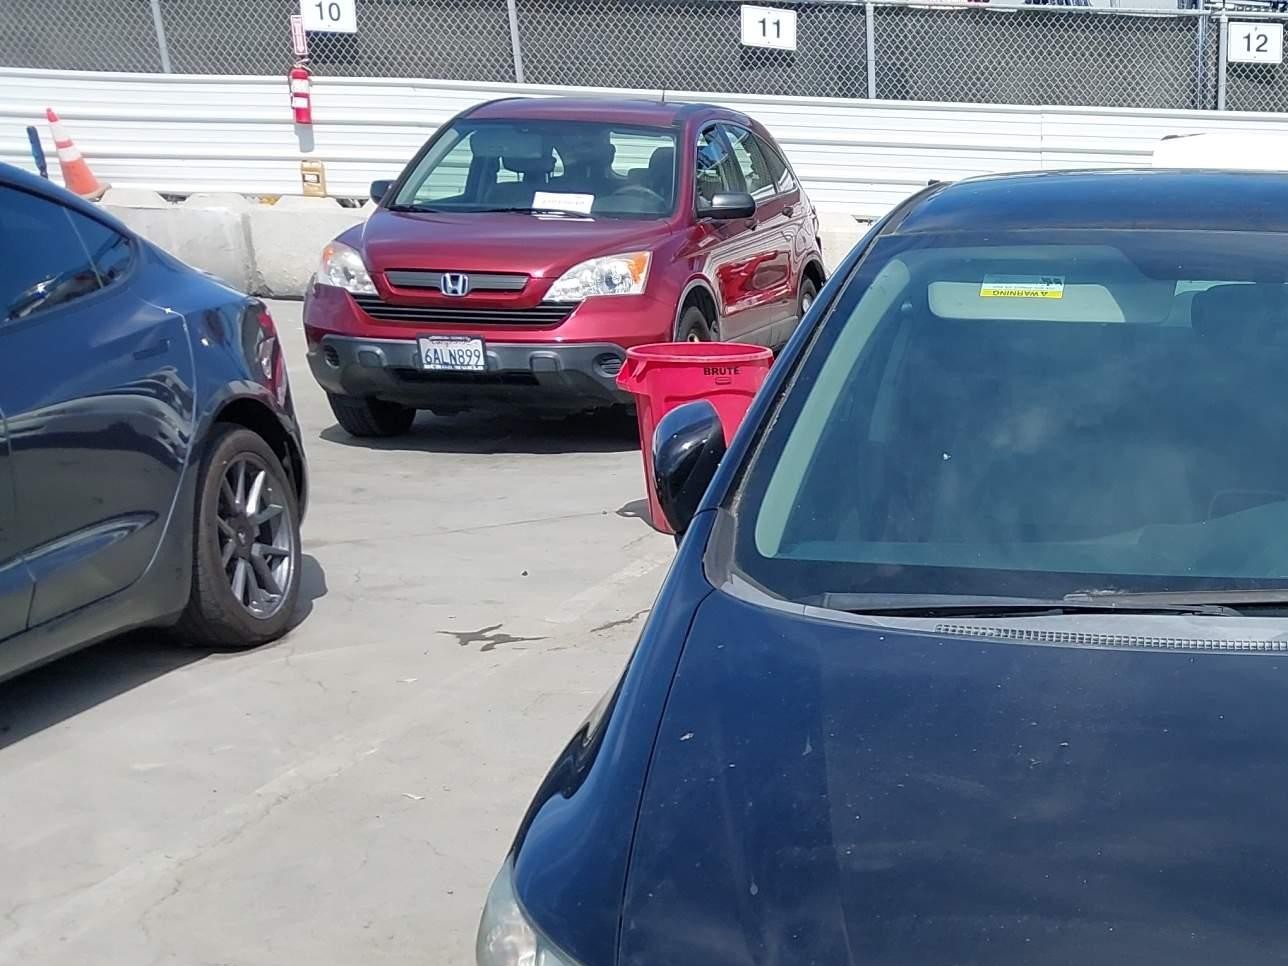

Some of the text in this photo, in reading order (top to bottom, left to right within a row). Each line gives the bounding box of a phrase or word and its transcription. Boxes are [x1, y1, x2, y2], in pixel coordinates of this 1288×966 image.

[315, 2, 341, 21] 10
[758, 17, 780, 38] 11
[1243, 32, 1268, 53] 12
[424, 347, 481, 368] 6ALN899
[703, 366, 742, 376] BRUTE
